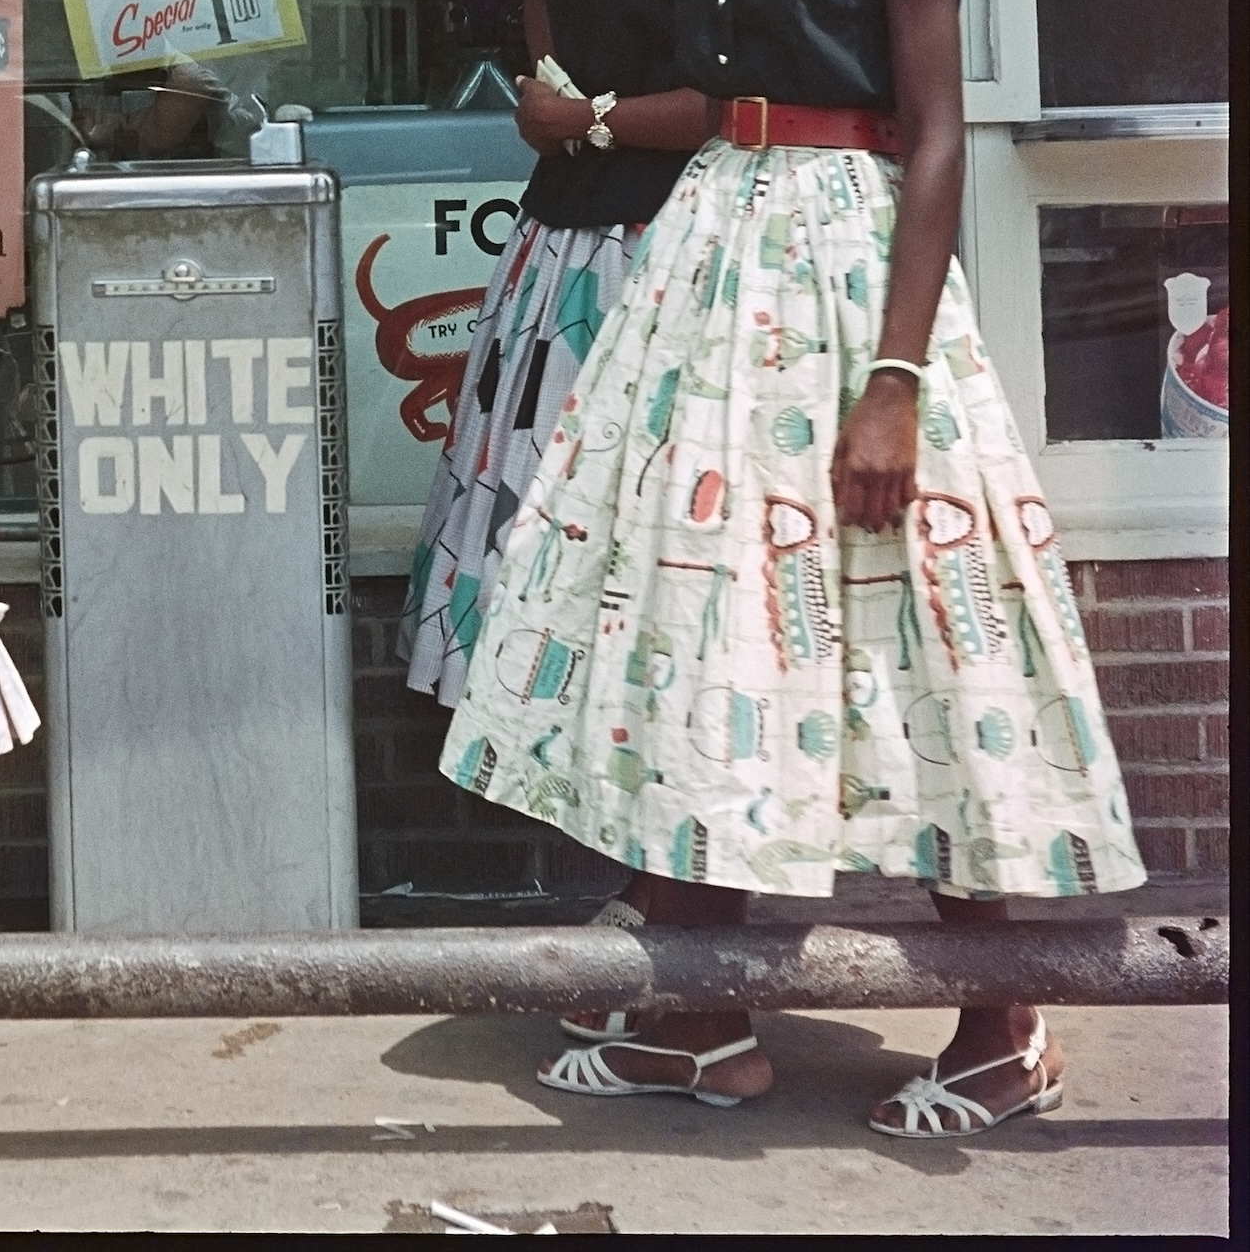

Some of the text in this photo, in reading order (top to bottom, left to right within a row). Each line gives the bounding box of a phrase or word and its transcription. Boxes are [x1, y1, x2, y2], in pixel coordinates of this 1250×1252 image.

[428, 322, 457, 339] TRY
[59, 337, 315, 426] WHITE
[79, 433, 307, 515] ONLY
